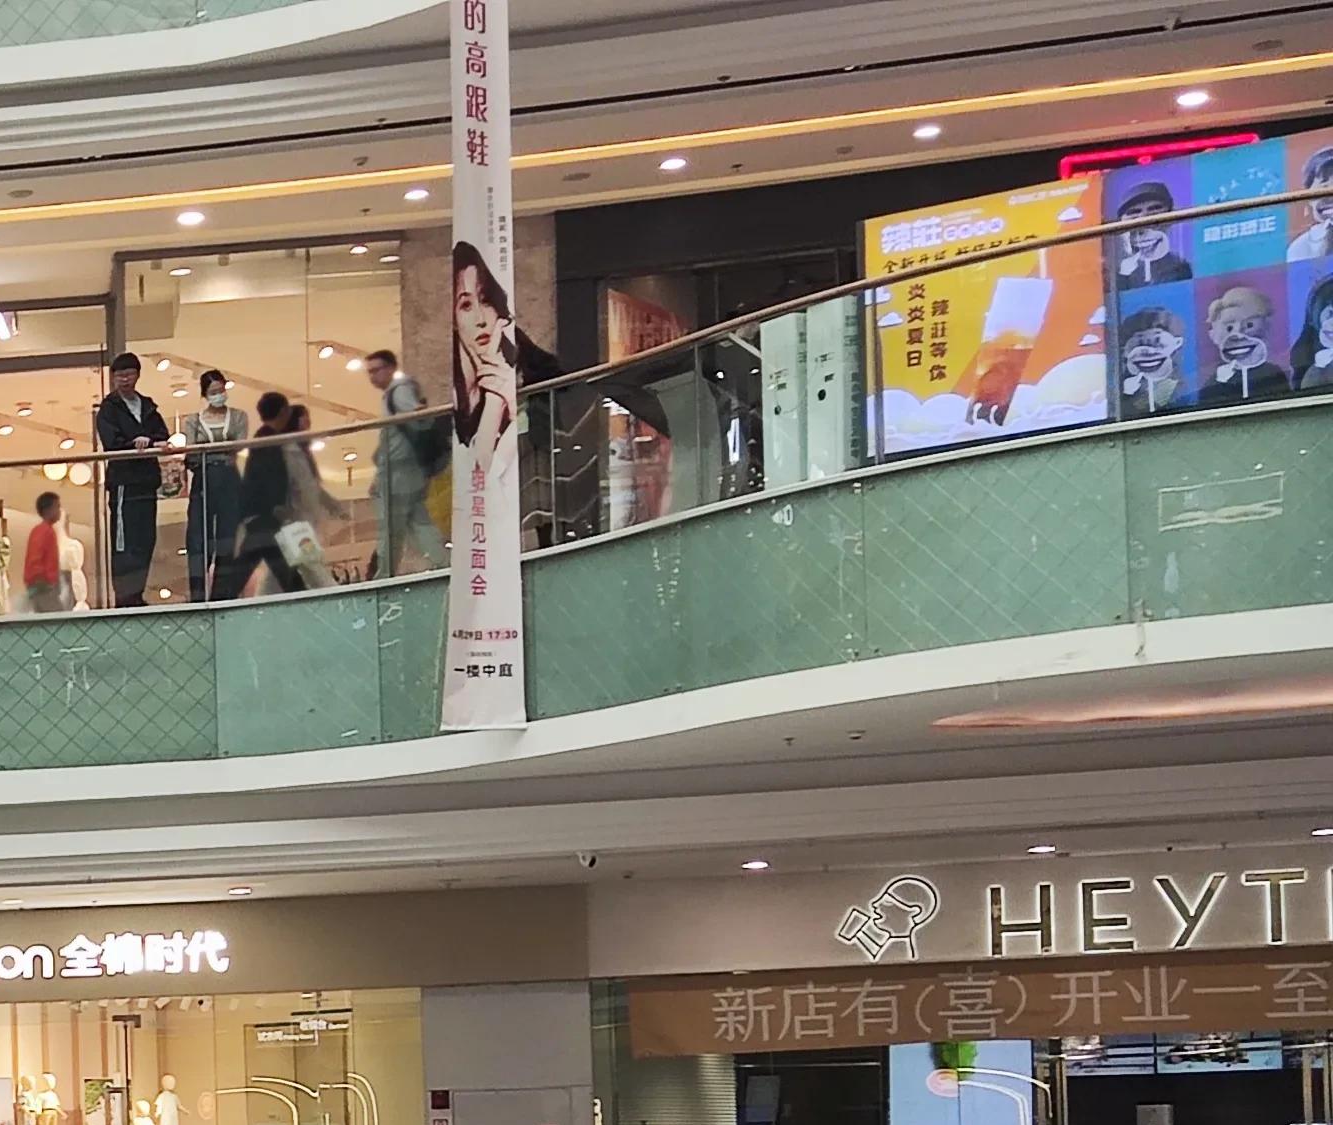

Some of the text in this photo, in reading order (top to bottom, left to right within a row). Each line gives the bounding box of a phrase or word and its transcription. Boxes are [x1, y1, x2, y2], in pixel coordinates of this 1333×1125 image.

[988, 867, 1333, 959] HEYT
[59, 930, 230, 979] 全棉时代
